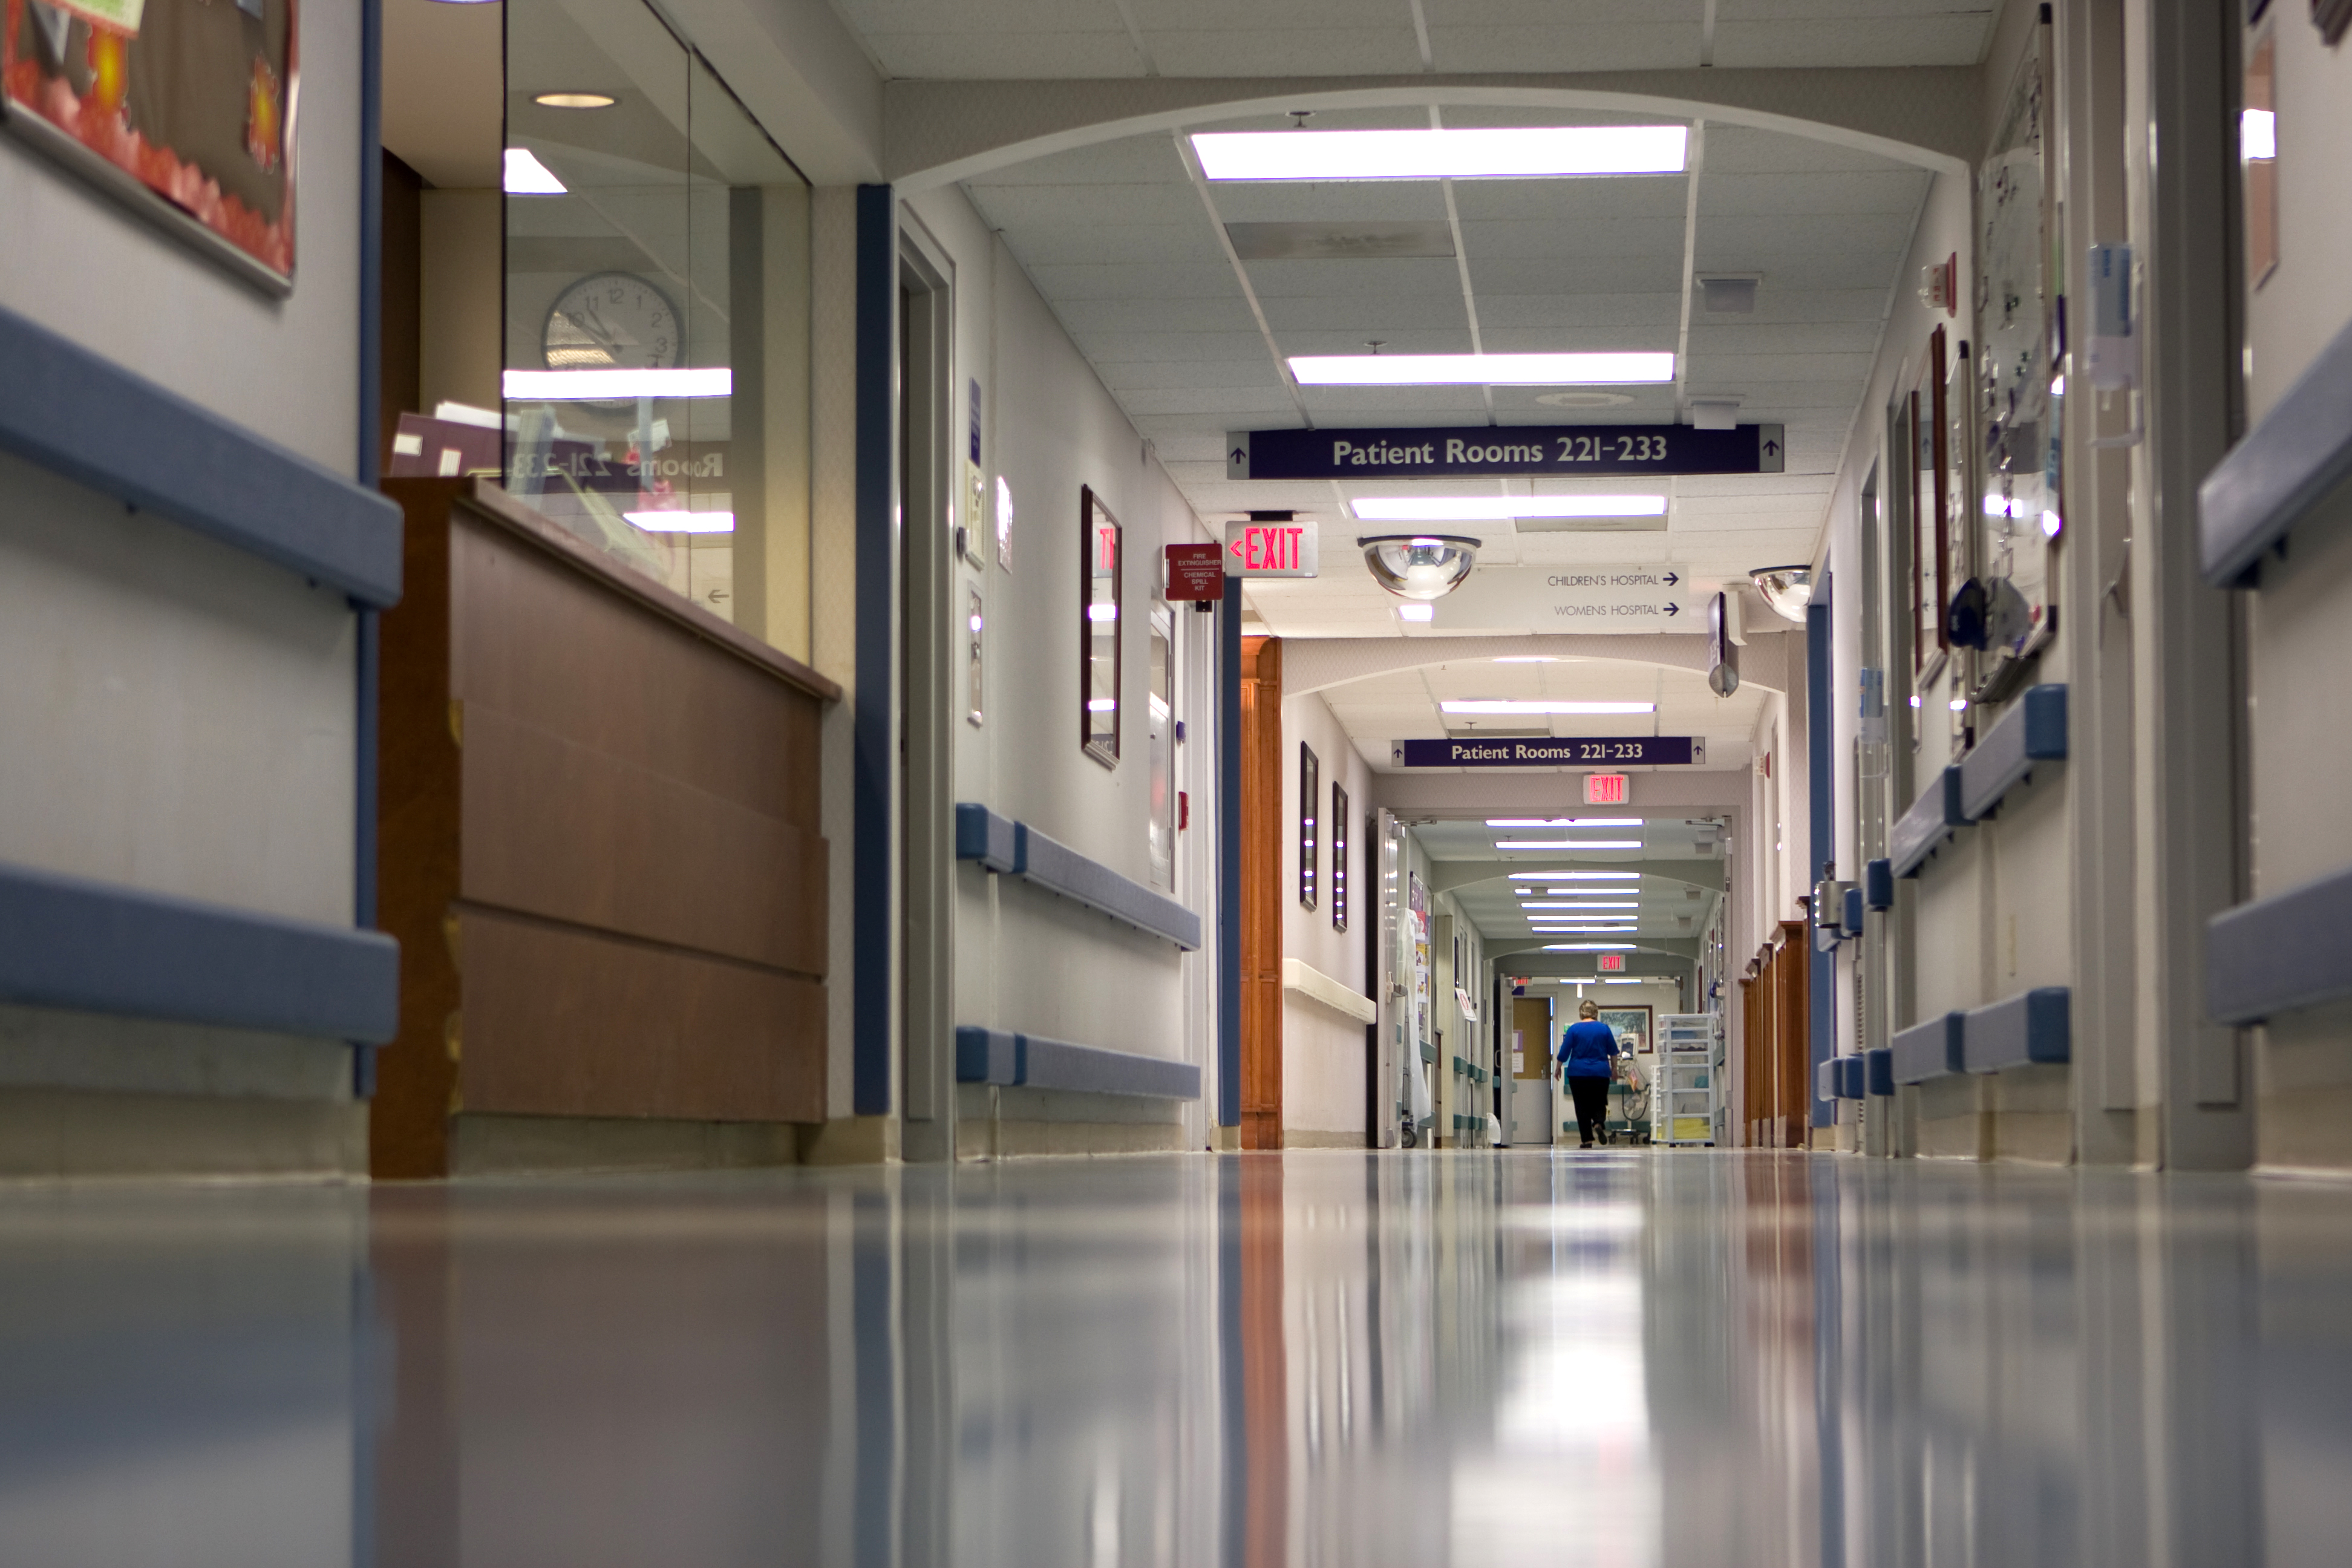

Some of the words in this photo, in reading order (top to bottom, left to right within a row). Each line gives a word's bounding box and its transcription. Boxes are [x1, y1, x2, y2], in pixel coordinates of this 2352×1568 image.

[652, 312, 663, 328] 2
[655, 337, 668, 353] 3
[1333, 440, 1434, 466] Patient
[1446, 439, 1543, 463] Rooms
[1557, 436, 1668, 462] 221-233
[1246, 528, 1304, 570] EXIT
[1547, 575, 1607, 586] CHILDREN'S
[1610, 575, 1659, 586] HOSPITAL
[1553, 606, 1607, 616] WOMENS
[1611, 605, 1659, 615] HOSPITAL
[1451, 745, 1509, 760] Patient
[1515, 745, 1571, 759] Rooms
[1580, 743, 1643, 759] 221-233
[1590, 775, 1624, 802] EXIT
[1602, 956, 1621, 970] EXIT
